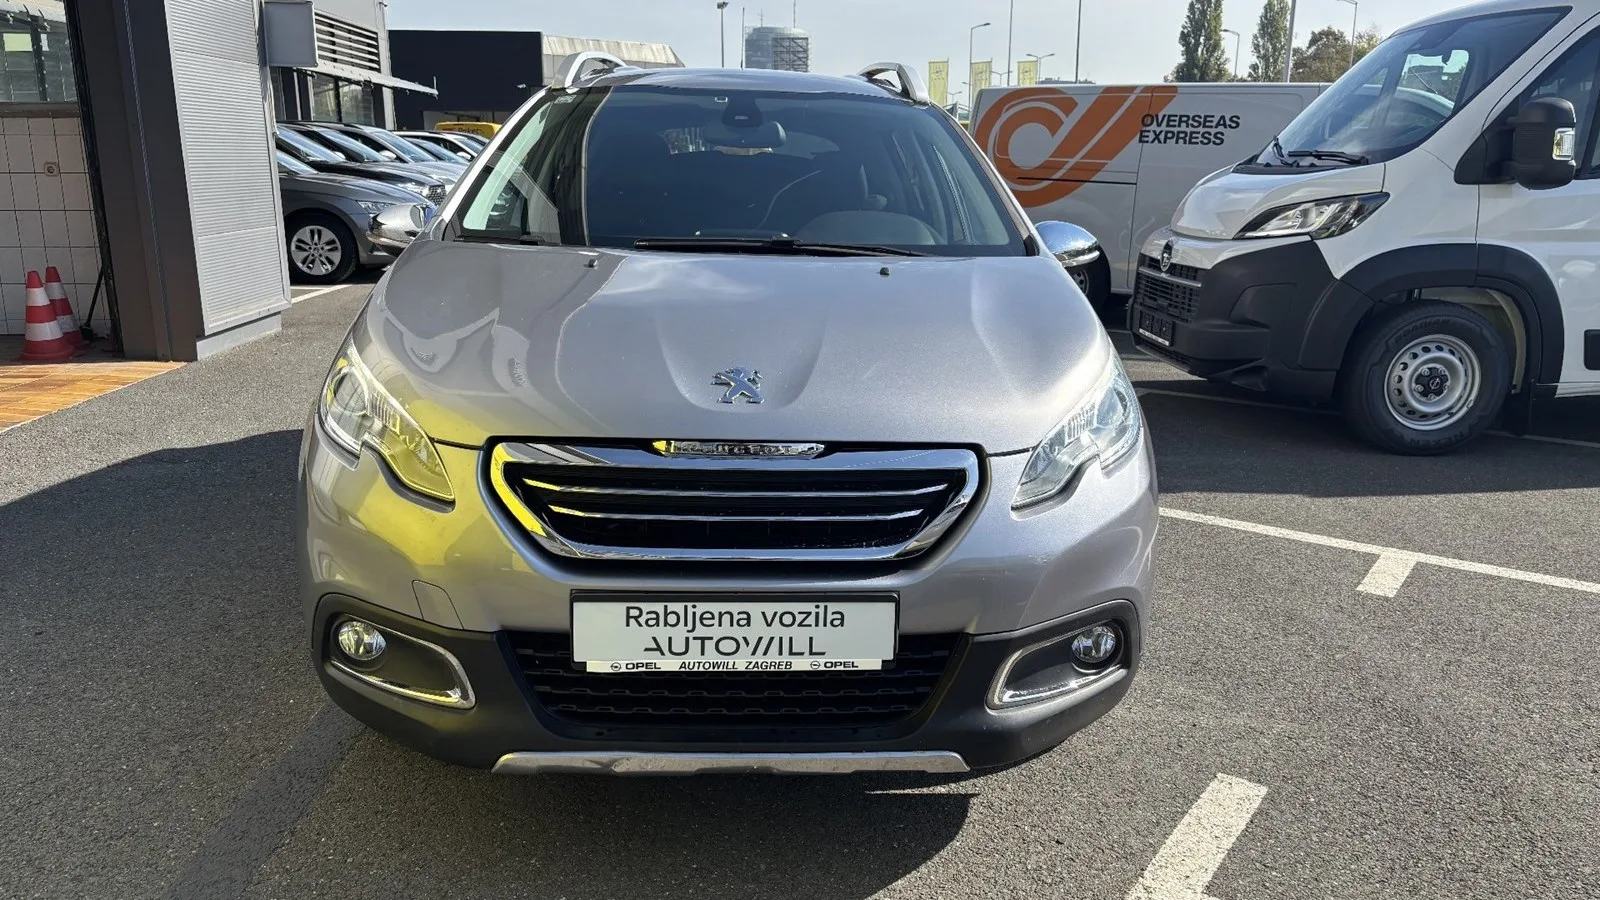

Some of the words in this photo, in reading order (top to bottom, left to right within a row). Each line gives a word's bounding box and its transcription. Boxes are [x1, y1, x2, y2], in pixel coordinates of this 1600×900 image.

[1141, 113, 1241, 129] OVERSEAS
[1138, 130, 1225, 146] EXPRESS
[625, 604, 751, 633] Rabljena
[761, 604, 846, 628] vozila
[643, 636, 827, 656] AUTOWILL
[625, 662, 661, 670] OPEL
[678, 661, 739, 671] AUTOWILL
[744, 661, 793, 670] ZAGREB
[823, 661, 859, 669] OPEL
